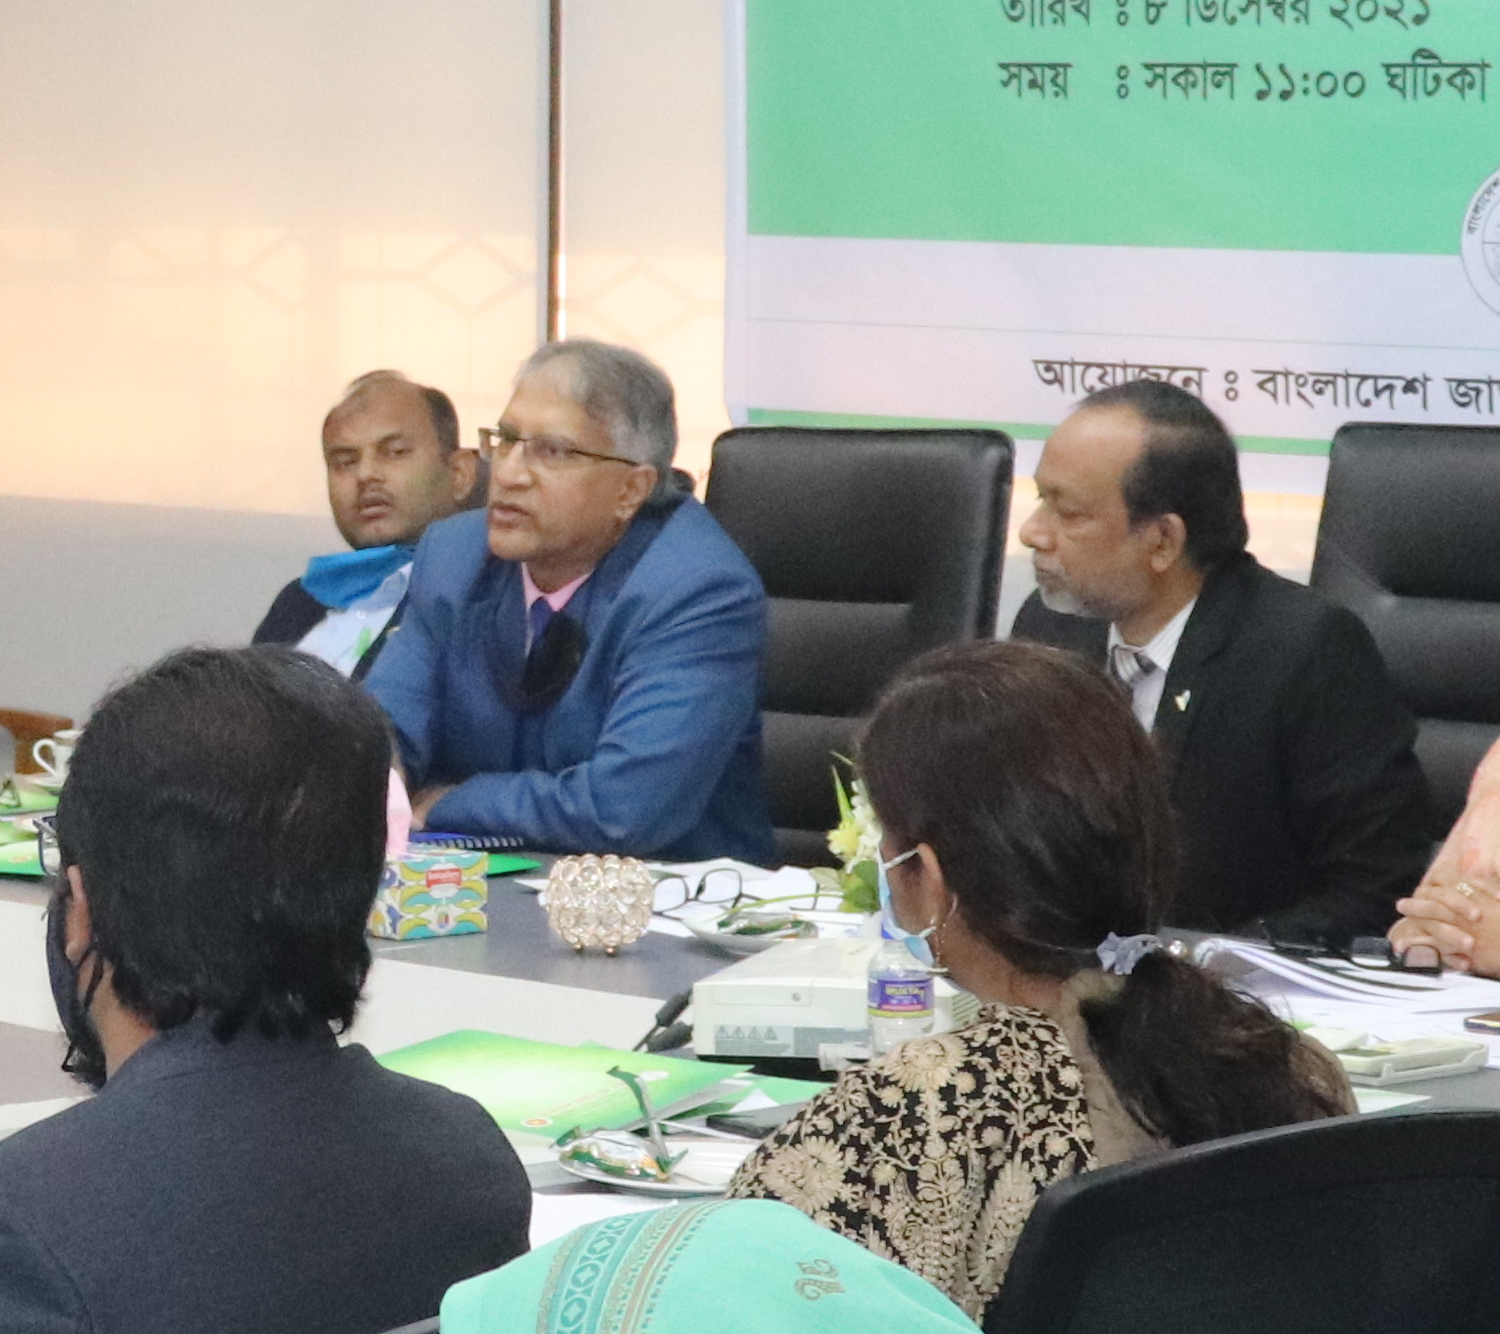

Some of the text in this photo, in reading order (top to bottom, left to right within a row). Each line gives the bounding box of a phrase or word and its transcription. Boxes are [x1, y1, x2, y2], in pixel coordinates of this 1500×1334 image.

[997, 62, 1073, 99] সময়
[1141, 61, 1238, 101] সকাল
[1381, 48, 1493, 103] ঘটিকা
[1256, 364, 1431, 412] বাংলাদেশ
